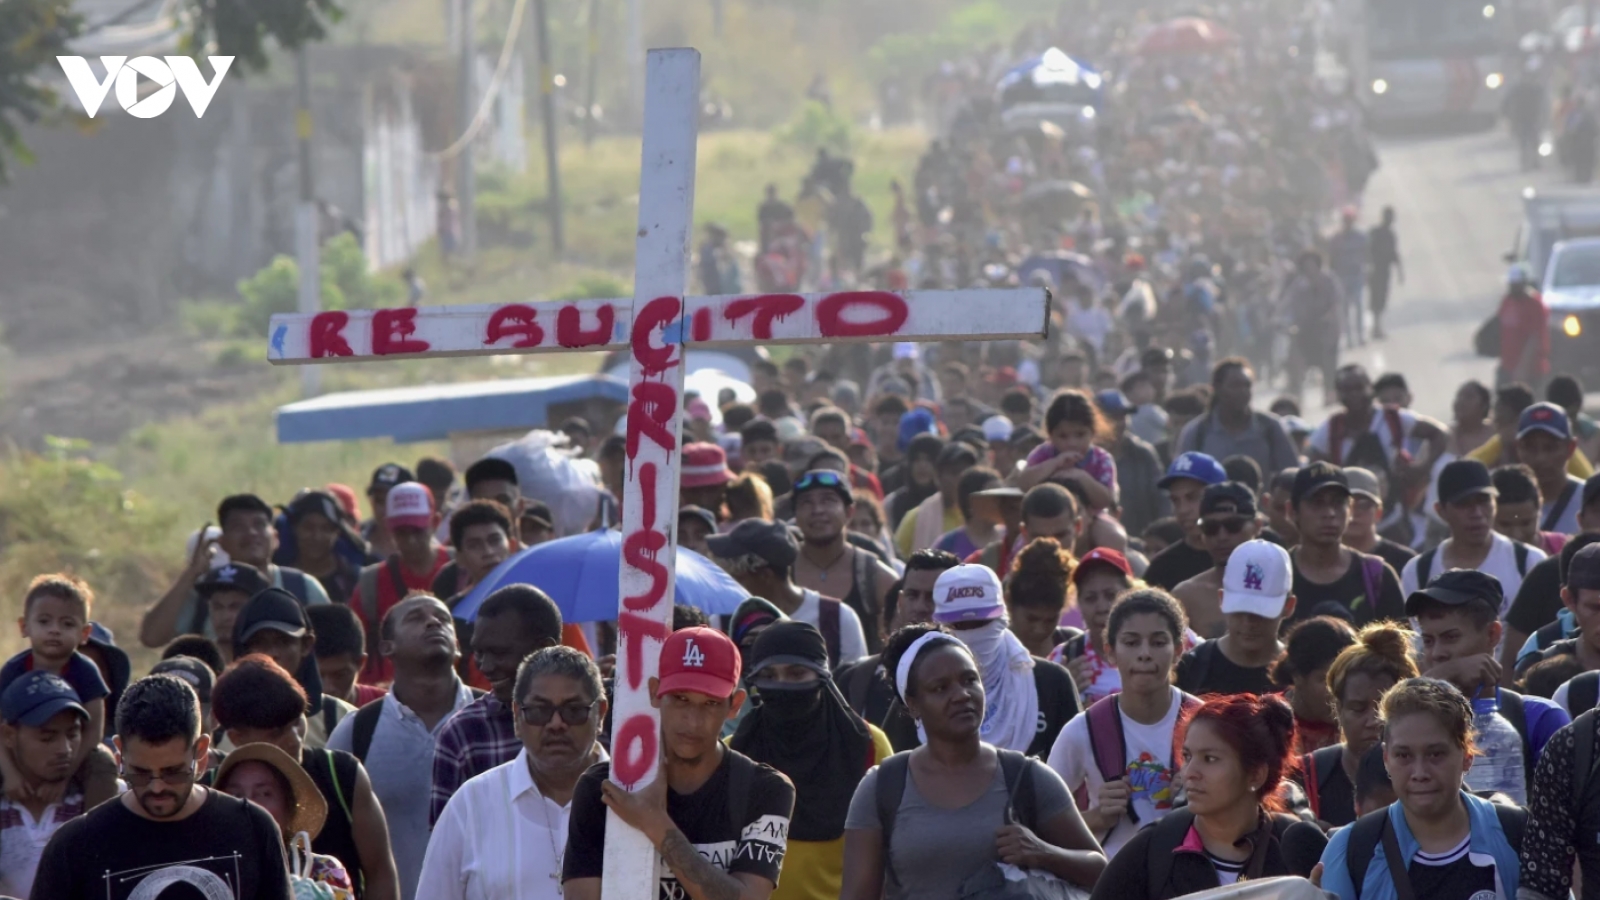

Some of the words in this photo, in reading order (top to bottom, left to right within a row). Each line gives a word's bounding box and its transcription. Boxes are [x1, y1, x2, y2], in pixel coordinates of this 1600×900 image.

[612, 296, 681, 785] CRISTO
[1243, 563, 1263, 590] LA
[944, 585, 985, 603] LAKERS
[682, 638, 705, 667] LA
